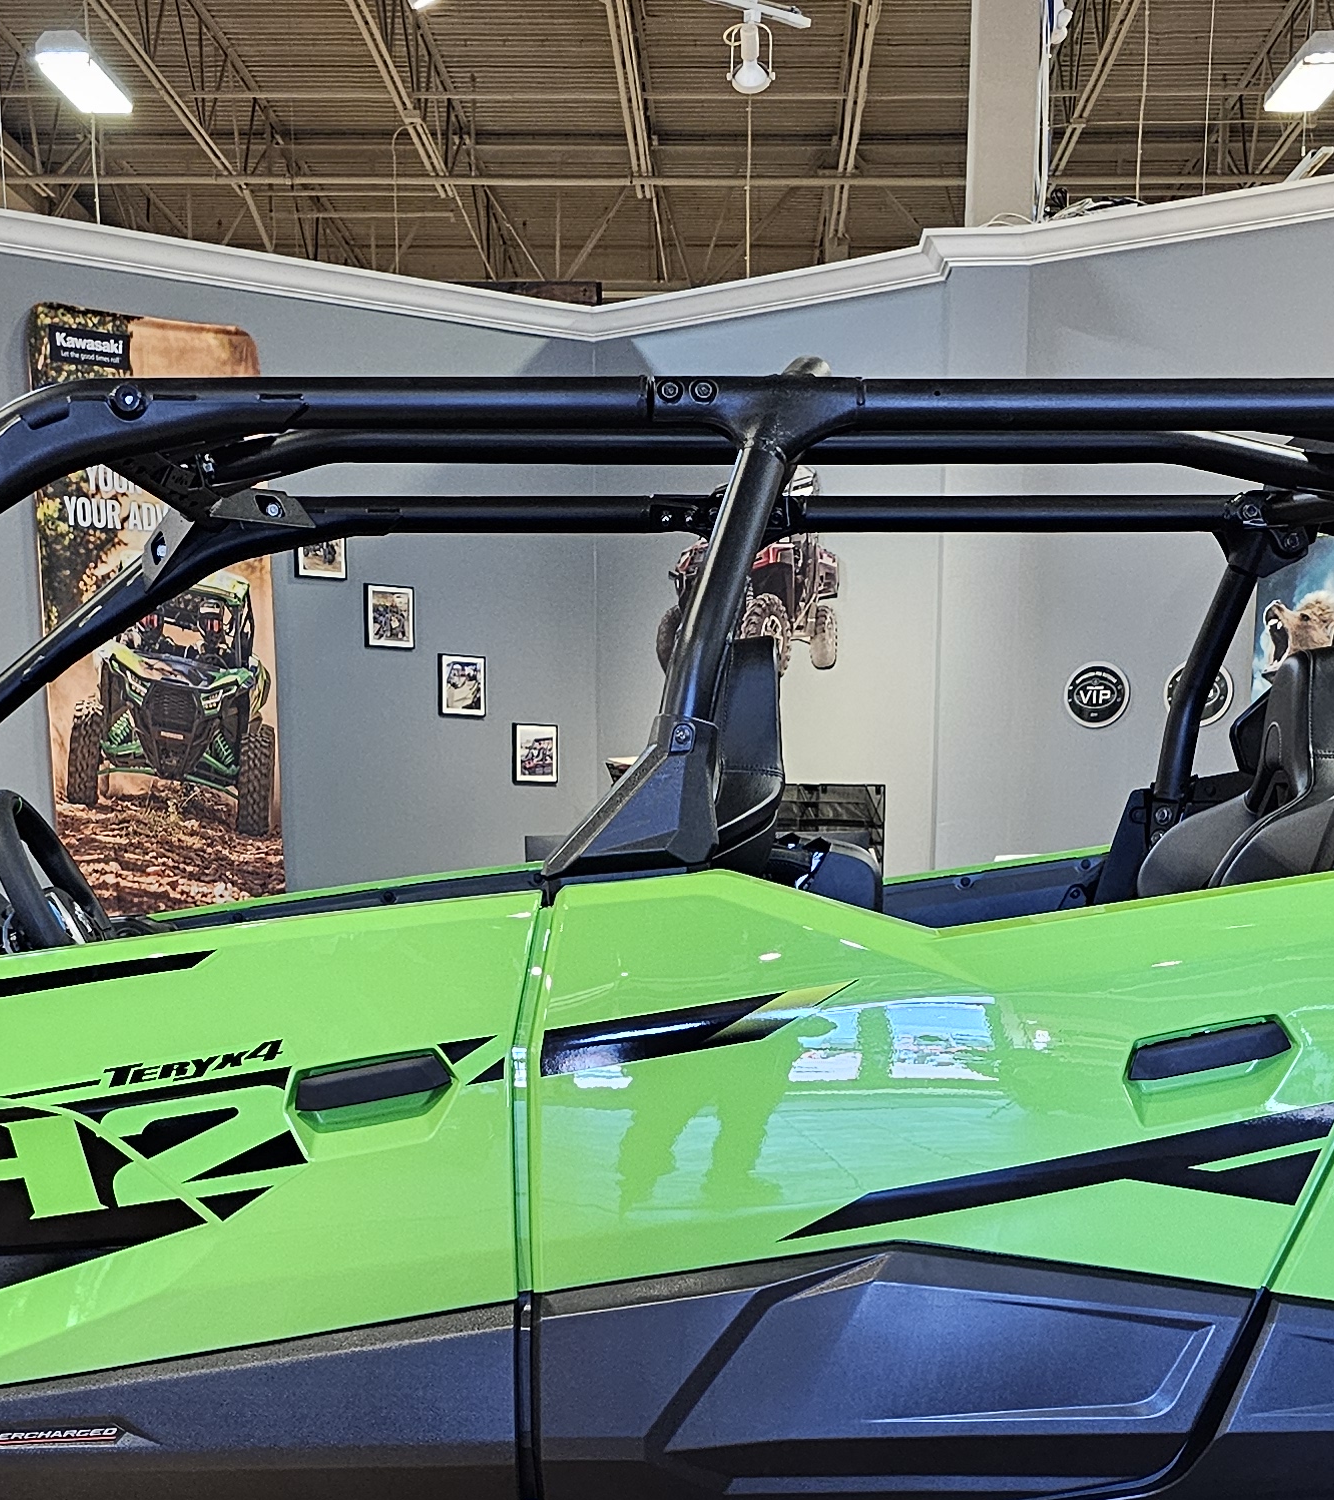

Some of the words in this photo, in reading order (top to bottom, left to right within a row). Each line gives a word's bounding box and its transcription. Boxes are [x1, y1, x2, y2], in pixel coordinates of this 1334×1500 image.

[55, 332, 123, 354] Kawasaki
[63, 496, 122, 529] YOUR
[1079, 690, 1111, 704] VIP
